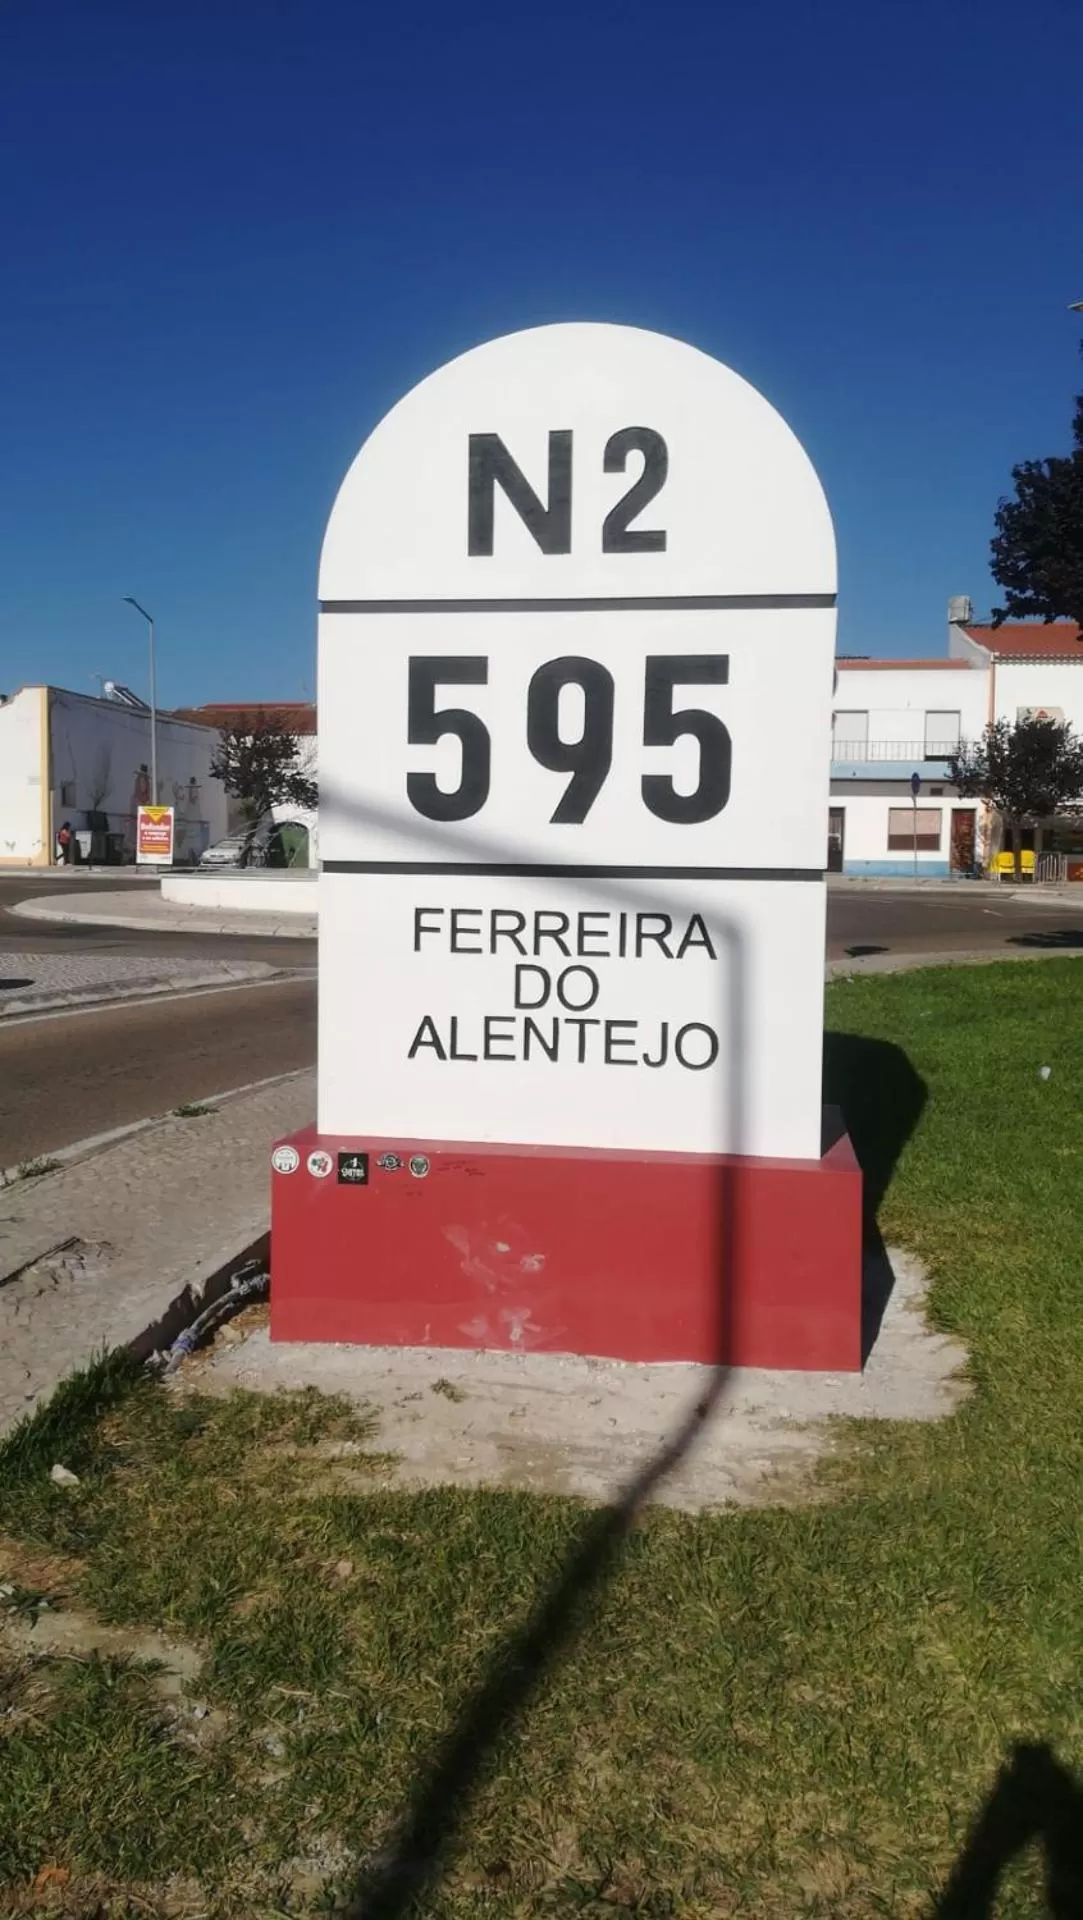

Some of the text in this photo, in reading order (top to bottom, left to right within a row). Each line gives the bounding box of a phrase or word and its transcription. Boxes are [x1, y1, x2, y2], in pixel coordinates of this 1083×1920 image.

[468, 427, 668, 556] N2
[407, 655, 731, 824] 595
[414, 907, 718, 960] FERREIRA
[514, 964, 600, 1011] DO
[407, 1015, 719, 1071] ALENTEJO
